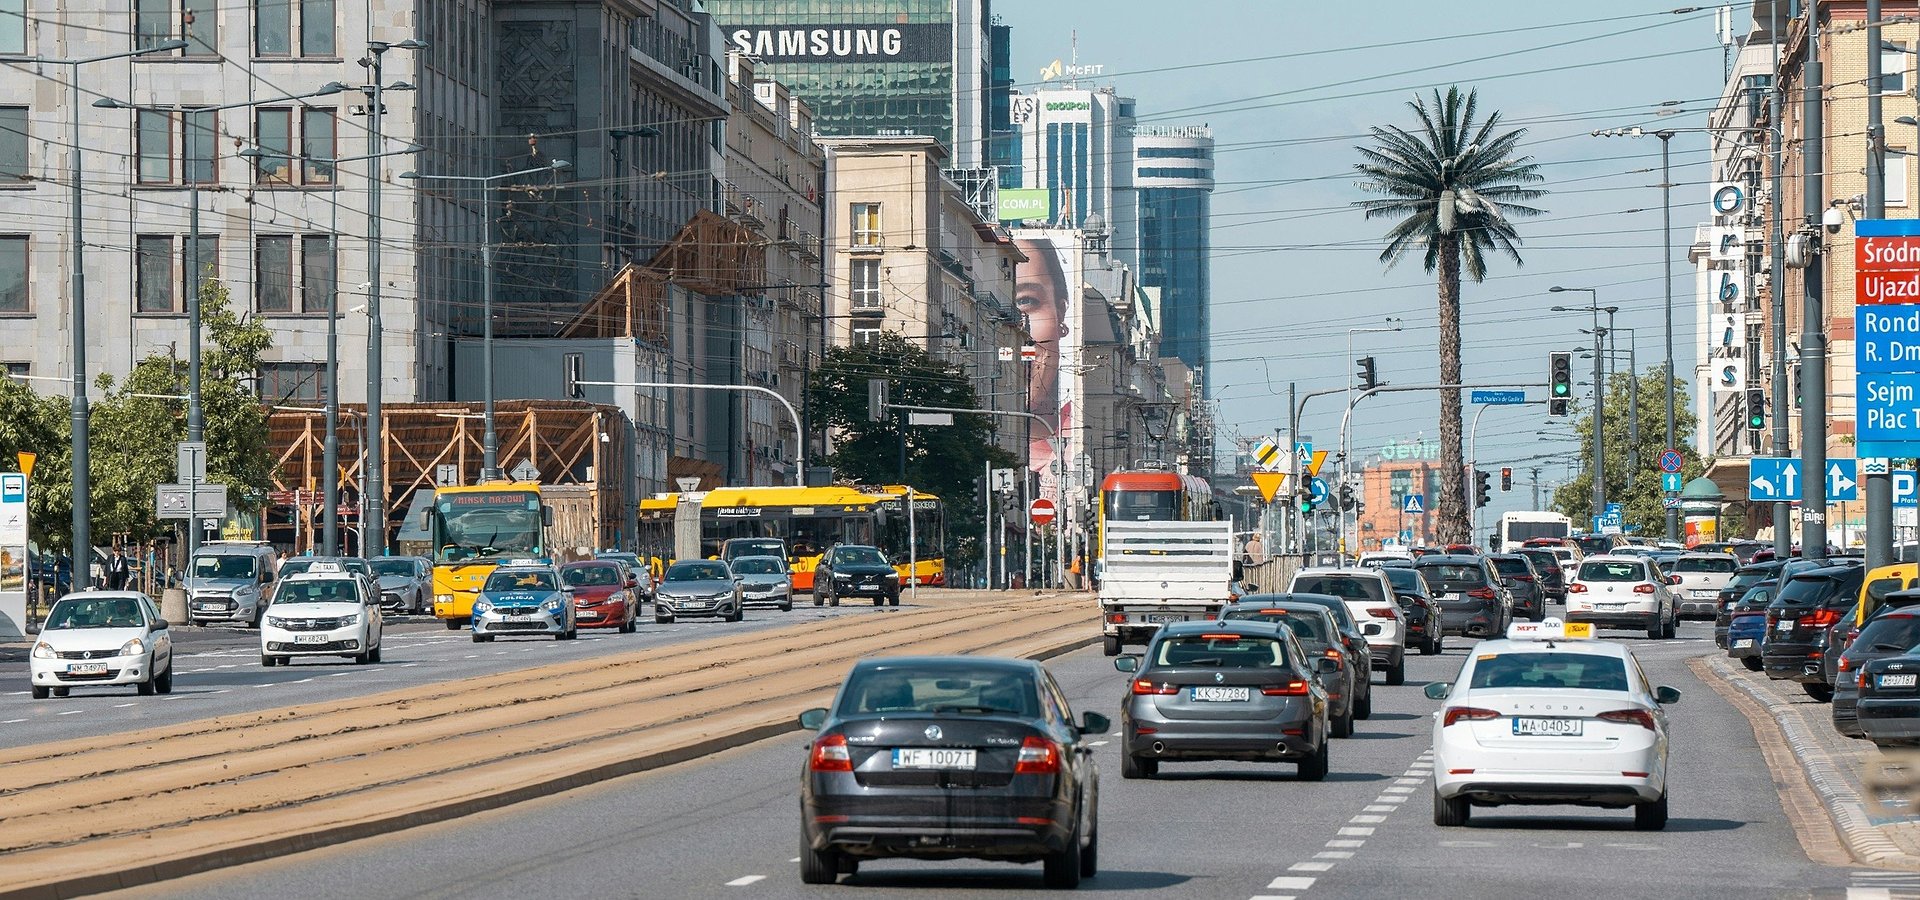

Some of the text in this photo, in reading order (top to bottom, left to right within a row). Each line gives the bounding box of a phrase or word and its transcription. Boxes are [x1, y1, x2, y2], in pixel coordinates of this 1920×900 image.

[732, 28, 902, 56] SAMSUNG
[1065, 65, 1103, 75] McFIT
[1046, 102, 1090, 111] GROUPON
[1713, 185, 1746, 388] Orbis
[1865, 274, 1920, 303] Ujazd
[1865, 310, 1920, 333] Rond
[1865, 341, 1883, 362] R.
[1867, 380, 1914, 407] Sejm
[1868, 407, 1907, 429] Plac
[1381, 440, 1440, 460] devir
[1198, 688, 1247, 698] KK 57286
[1521, 720, 1577, 732] WA 0405J
[903, 751, 973, 764] WF 1007T
